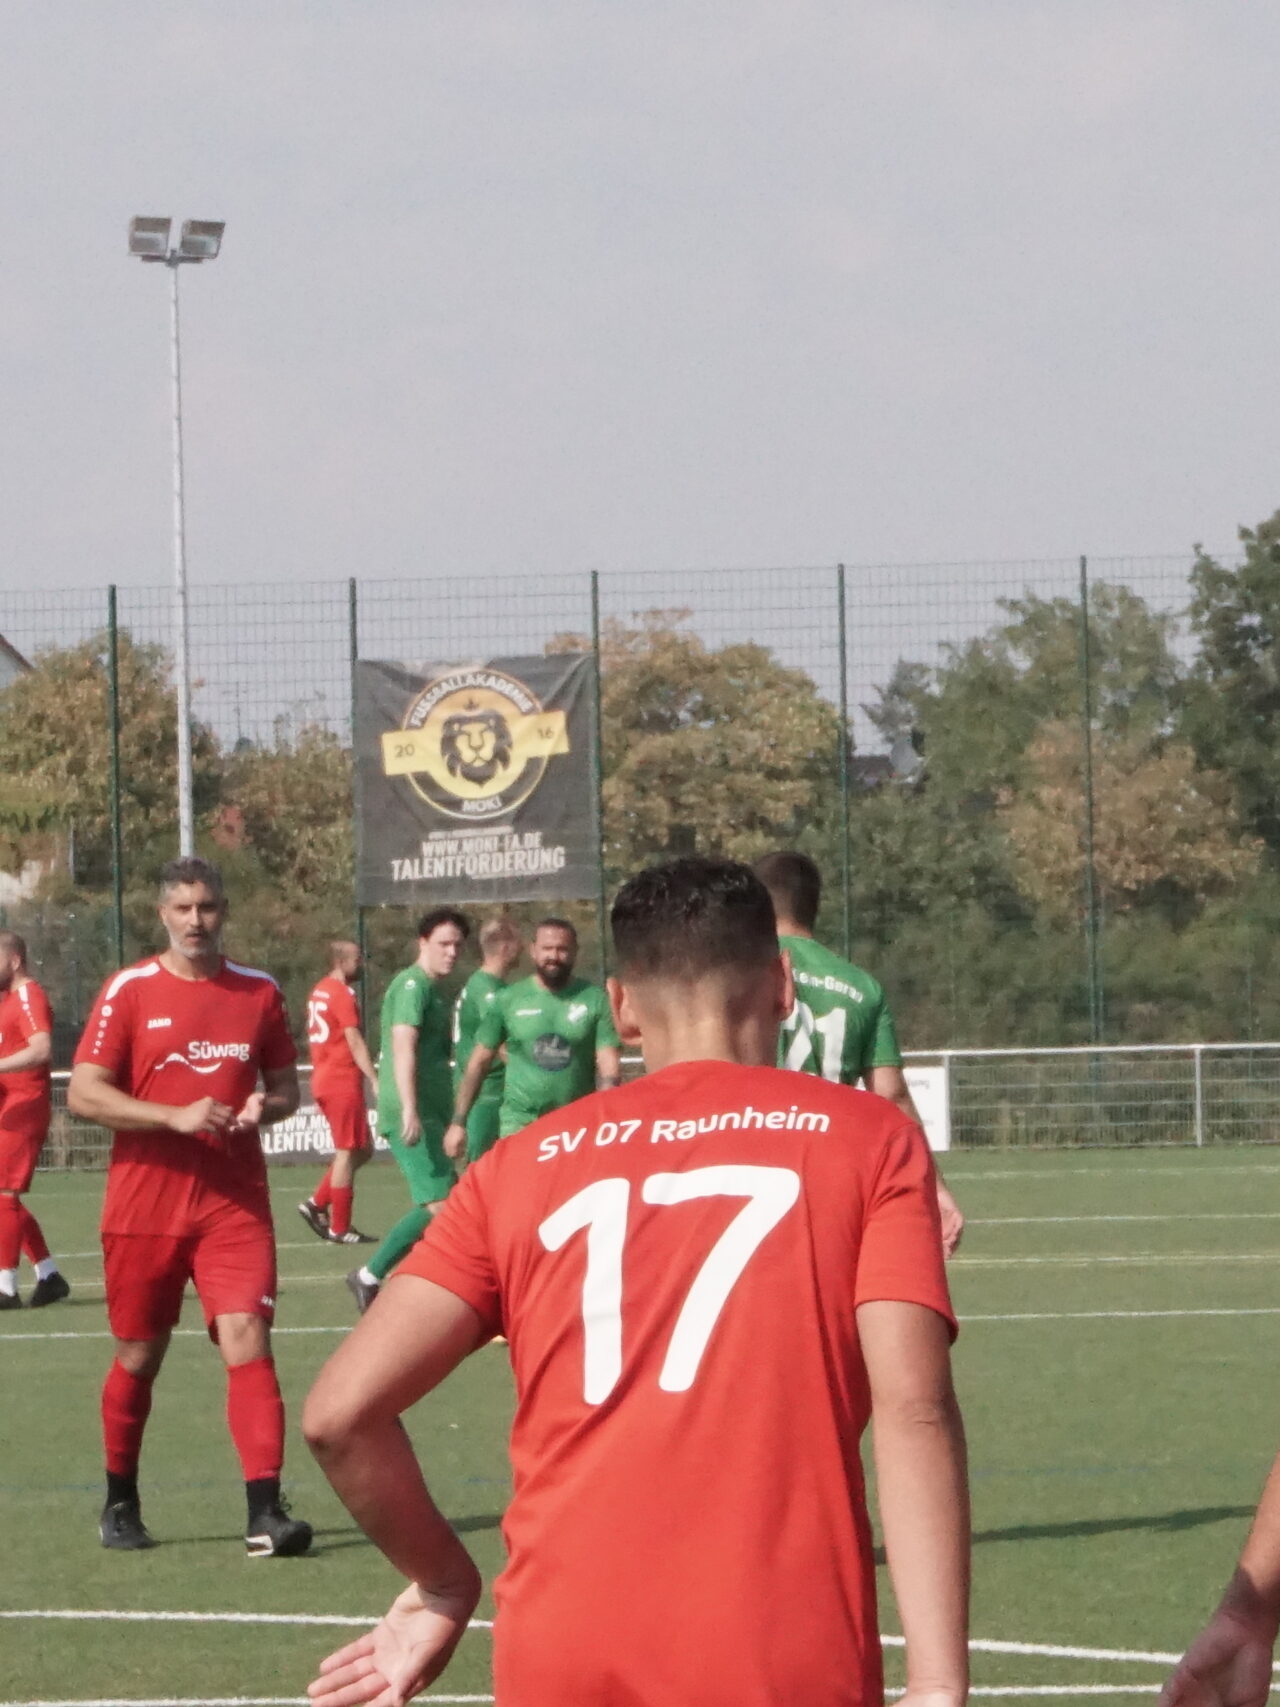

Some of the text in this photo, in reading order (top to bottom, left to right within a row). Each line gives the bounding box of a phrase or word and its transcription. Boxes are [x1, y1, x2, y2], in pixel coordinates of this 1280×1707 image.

[394, 743, 416, 759] 20
[461, 796, 503, 813] MOKI
[188, 1040, 251, 1061] Süwag
[538, 1106, 831, 1162] SV 07 Raunheim
[538, 1165, 801, 1406] 17
